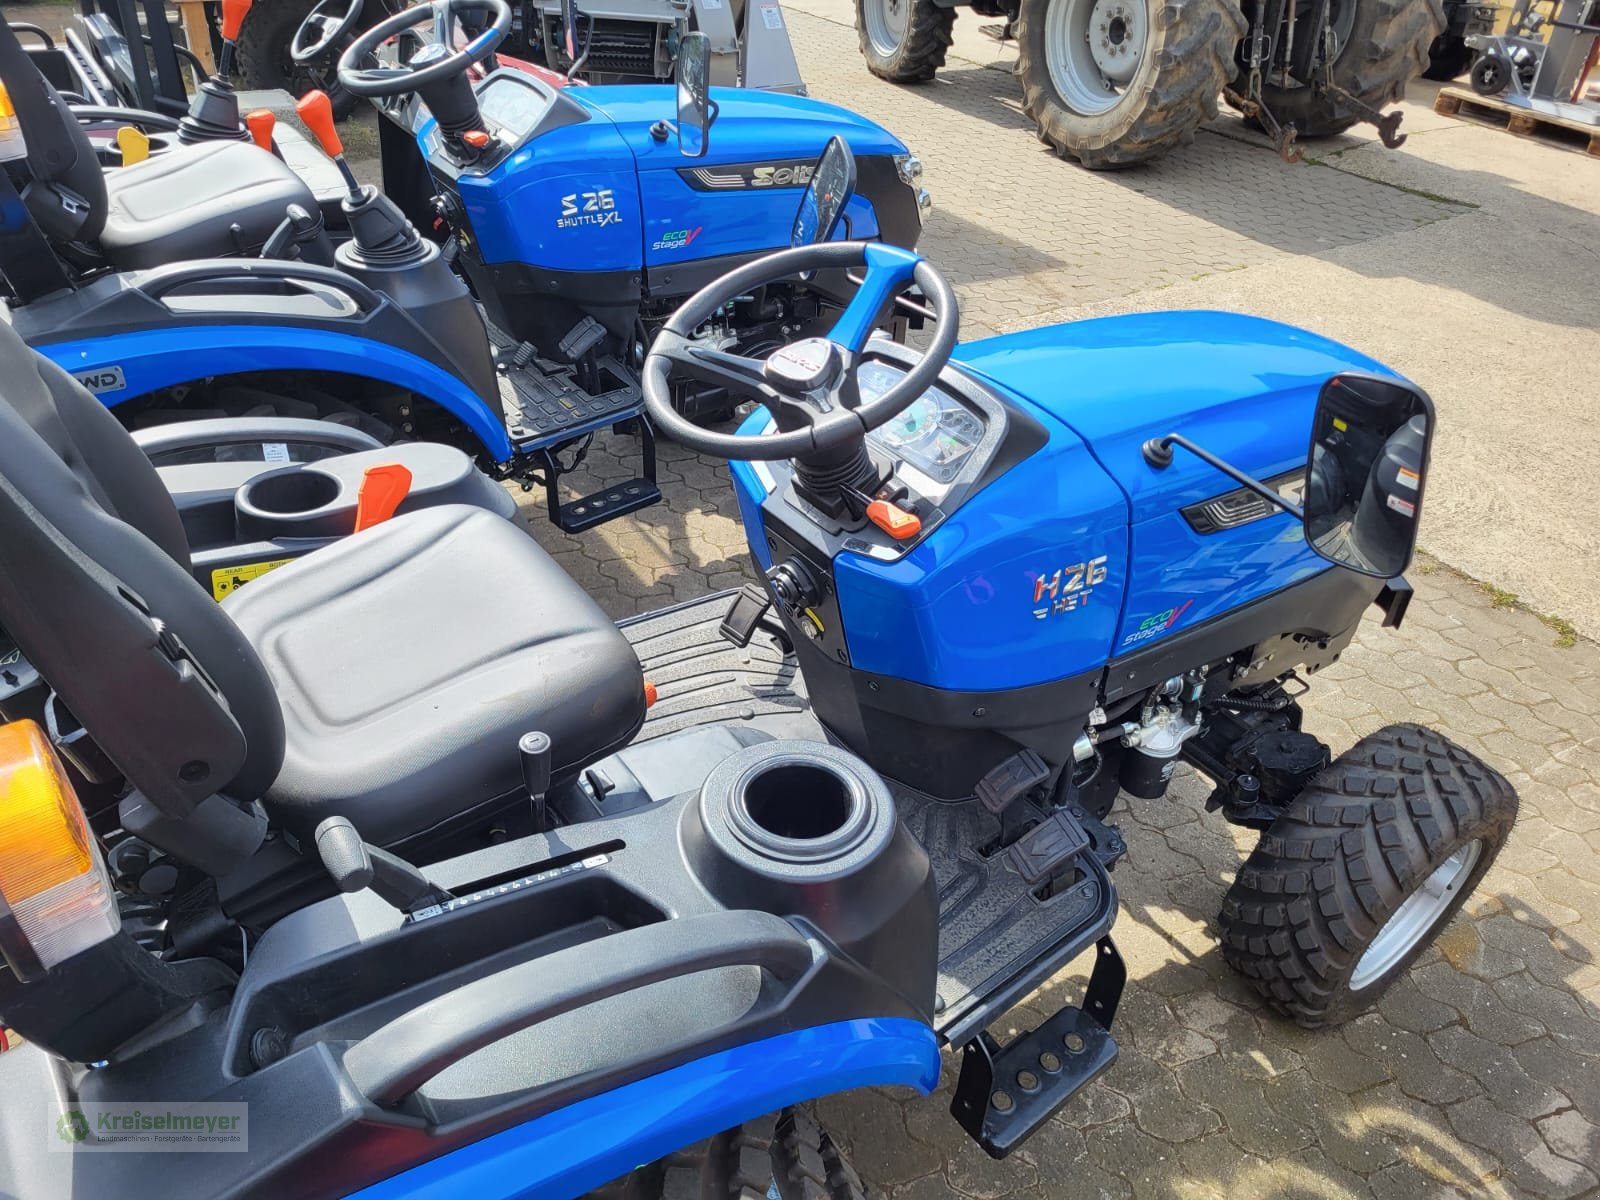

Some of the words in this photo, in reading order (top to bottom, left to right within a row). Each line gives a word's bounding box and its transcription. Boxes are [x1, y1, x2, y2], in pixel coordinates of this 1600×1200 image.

[561, 193, 579, 216] S
[582, 189, 615, 211] 26
[77, 373, 118, 388] WD
